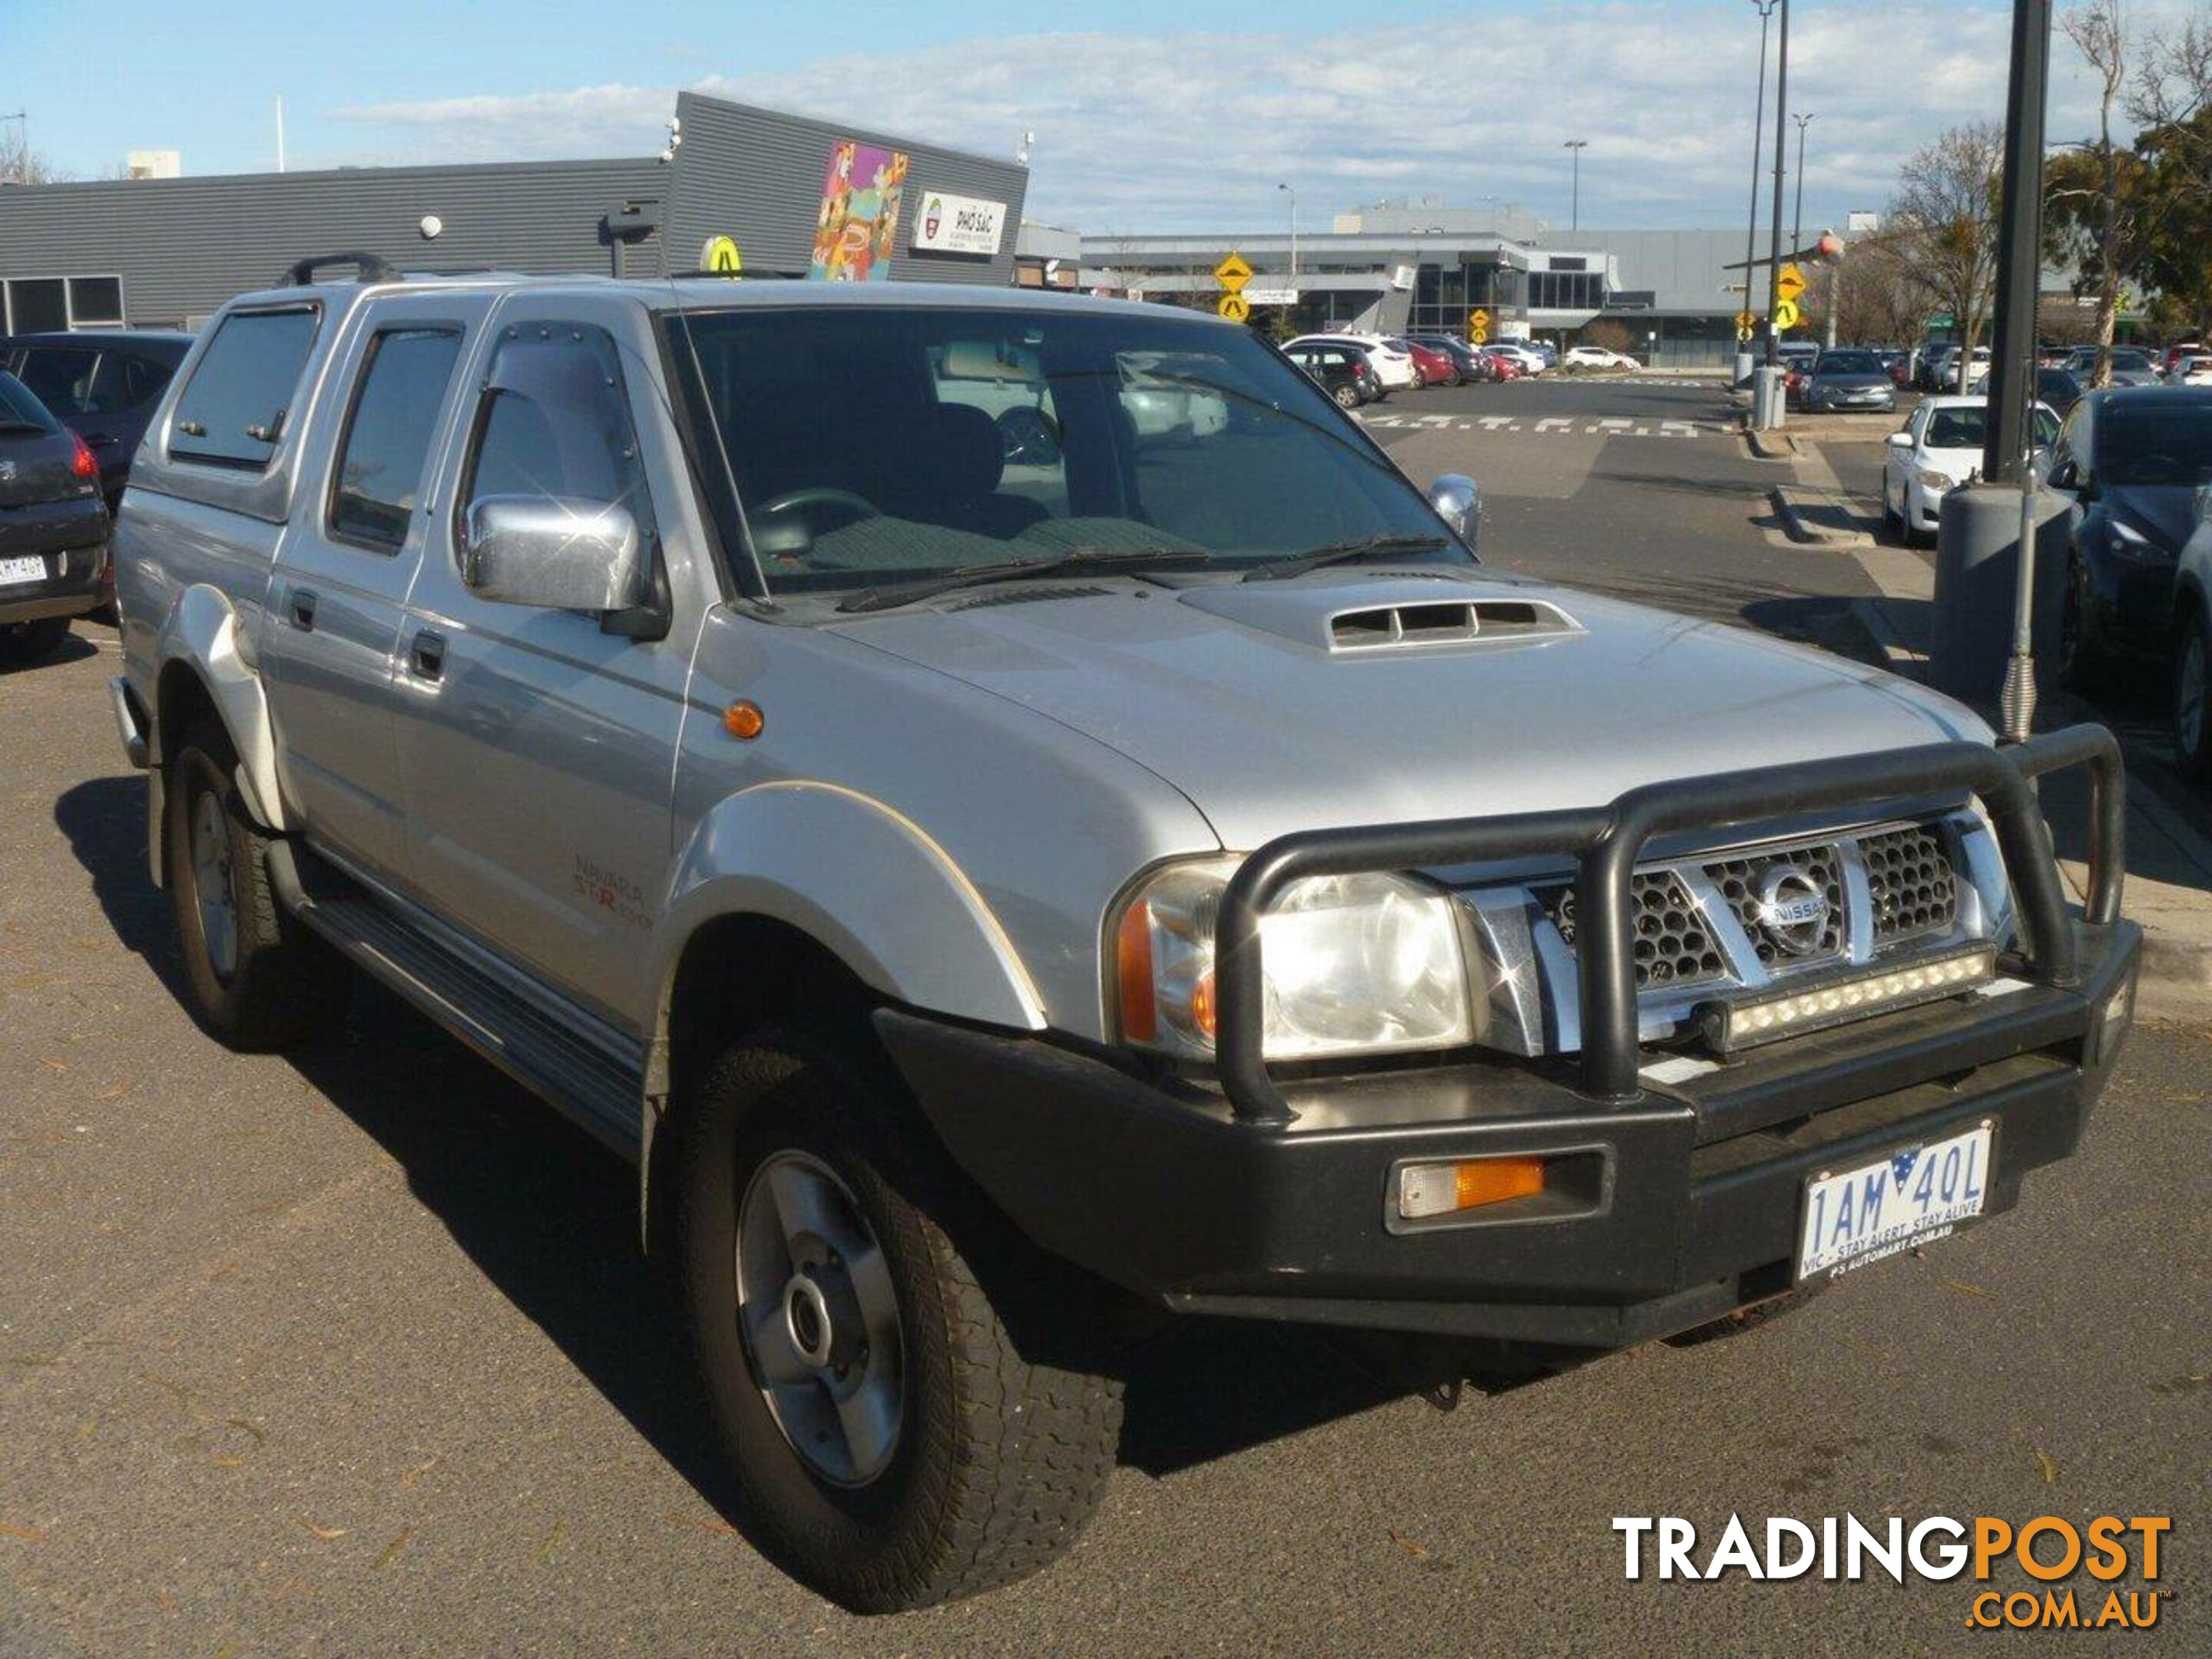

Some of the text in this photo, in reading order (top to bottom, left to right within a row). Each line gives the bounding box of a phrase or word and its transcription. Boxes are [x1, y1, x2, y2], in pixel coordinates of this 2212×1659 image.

[575, 853, 645, 909] NAVARA
[1803, 1253, 1824, 1273] VIC
[1838, 1237, 1868, 1256] STAY
[1870, 1223, 1907, 1245] ALERT
[1914, 1210, 1943, 1229] STAY
[1945, 1199, 1978, 1220] ALIVE
[1815, 1169, 1888, 1253] 1AM
